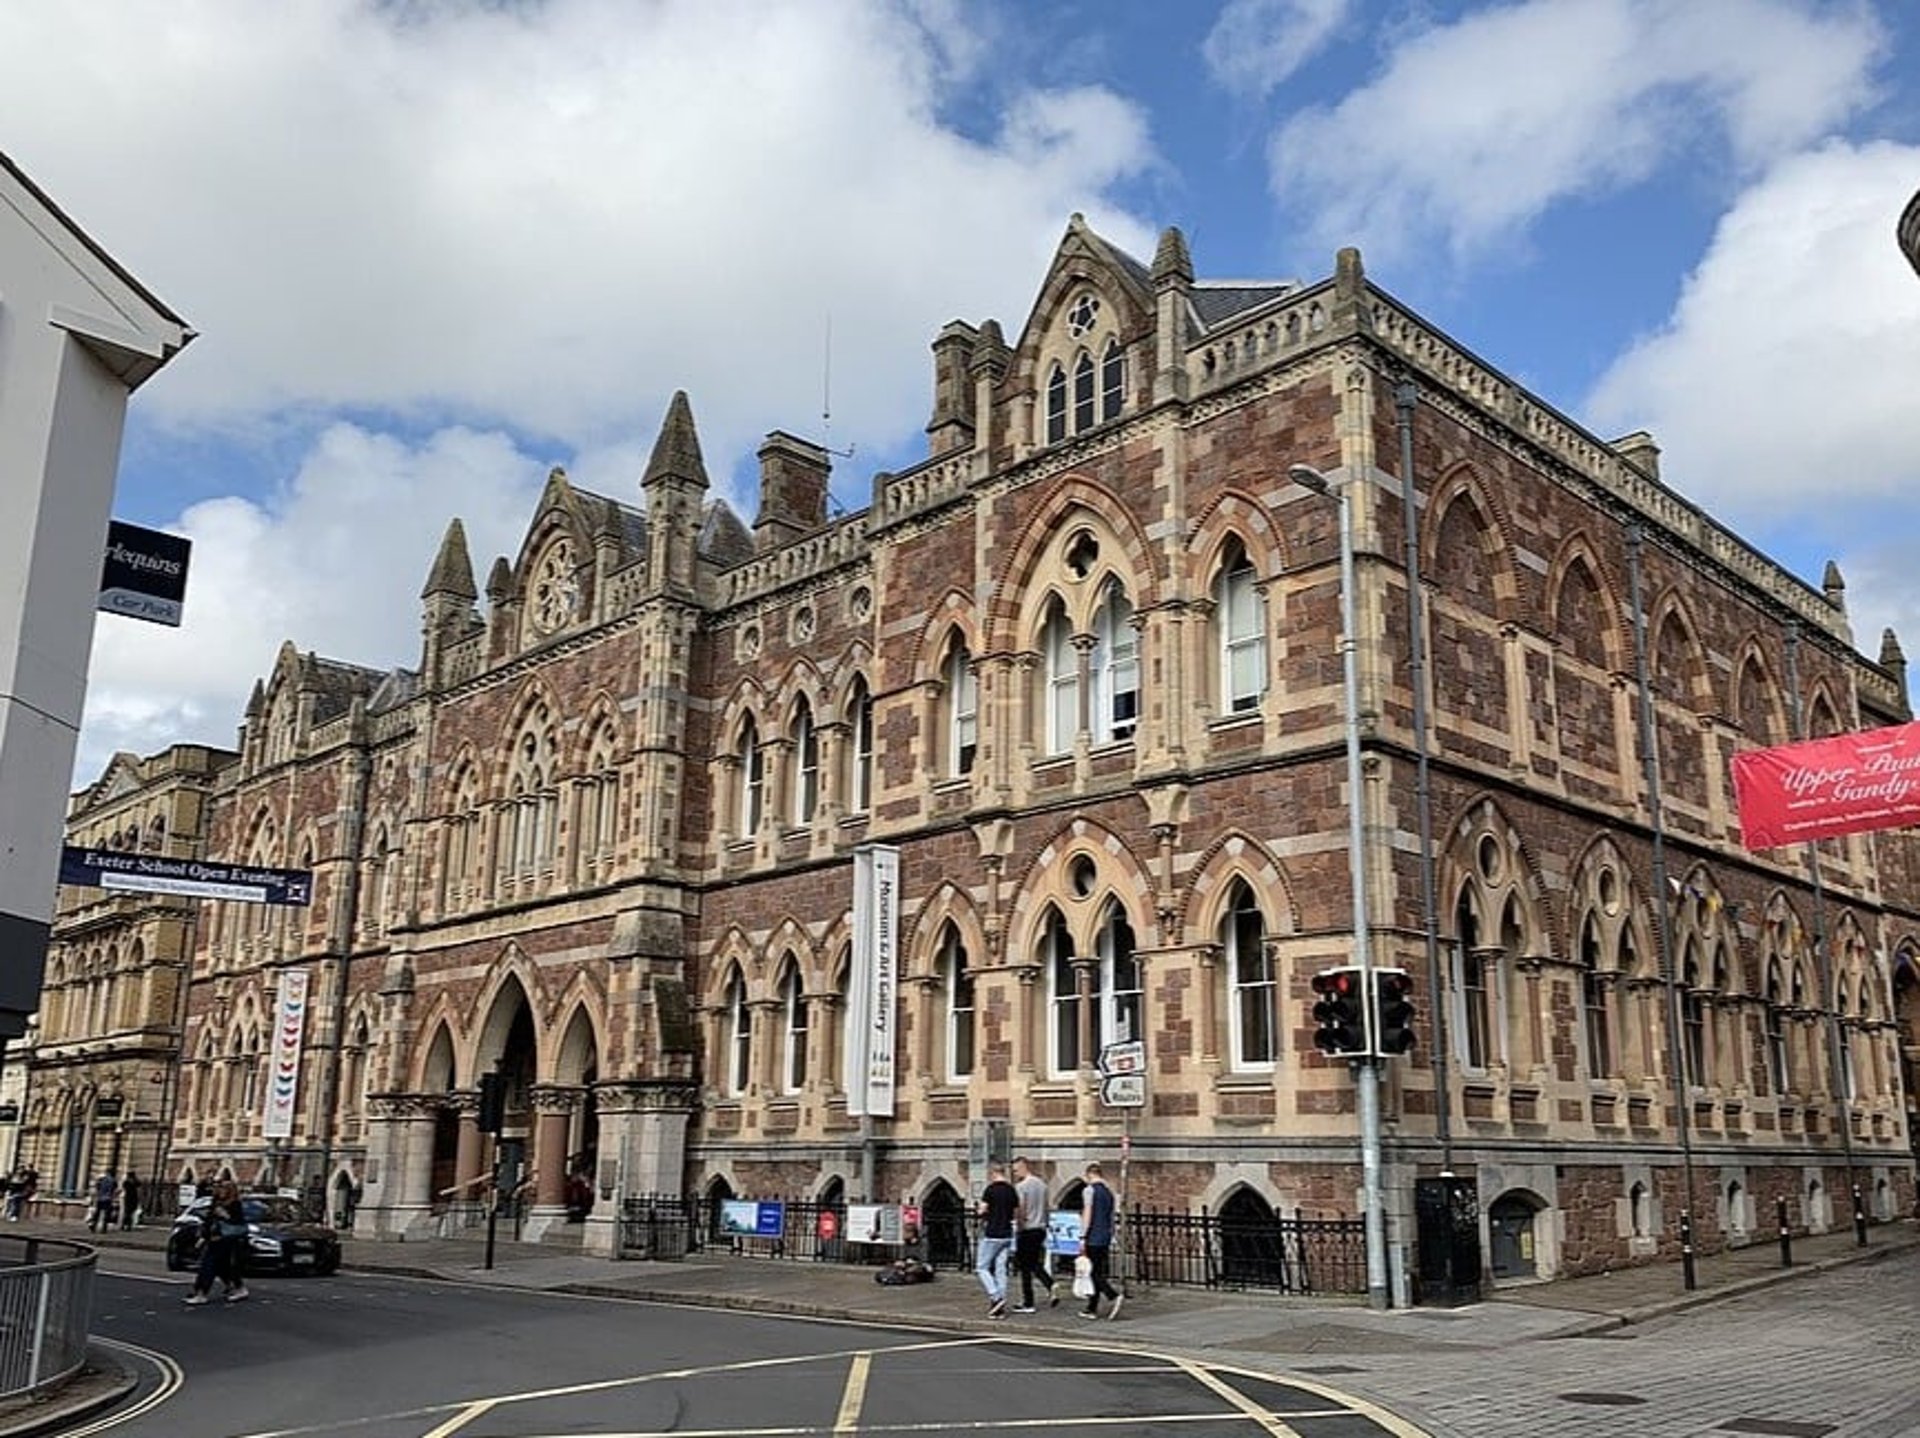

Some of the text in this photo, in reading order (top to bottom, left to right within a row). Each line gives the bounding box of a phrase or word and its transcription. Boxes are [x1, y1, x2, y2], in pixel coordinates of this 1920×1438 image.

[1780, 766, 1856, 797] Upper
[1831, 772, 1910, 802] Gandy
[83, 852, 135, 869] Exeter
[136, 858, 187, 876] School
[188, 864, 229, 881] Open
[229, 867, 286, 888] Evening
[879, 881, 891, 938] Museum
[879, 956, 890, 978] Art
[874, 981, 890, 1033] Gallery
